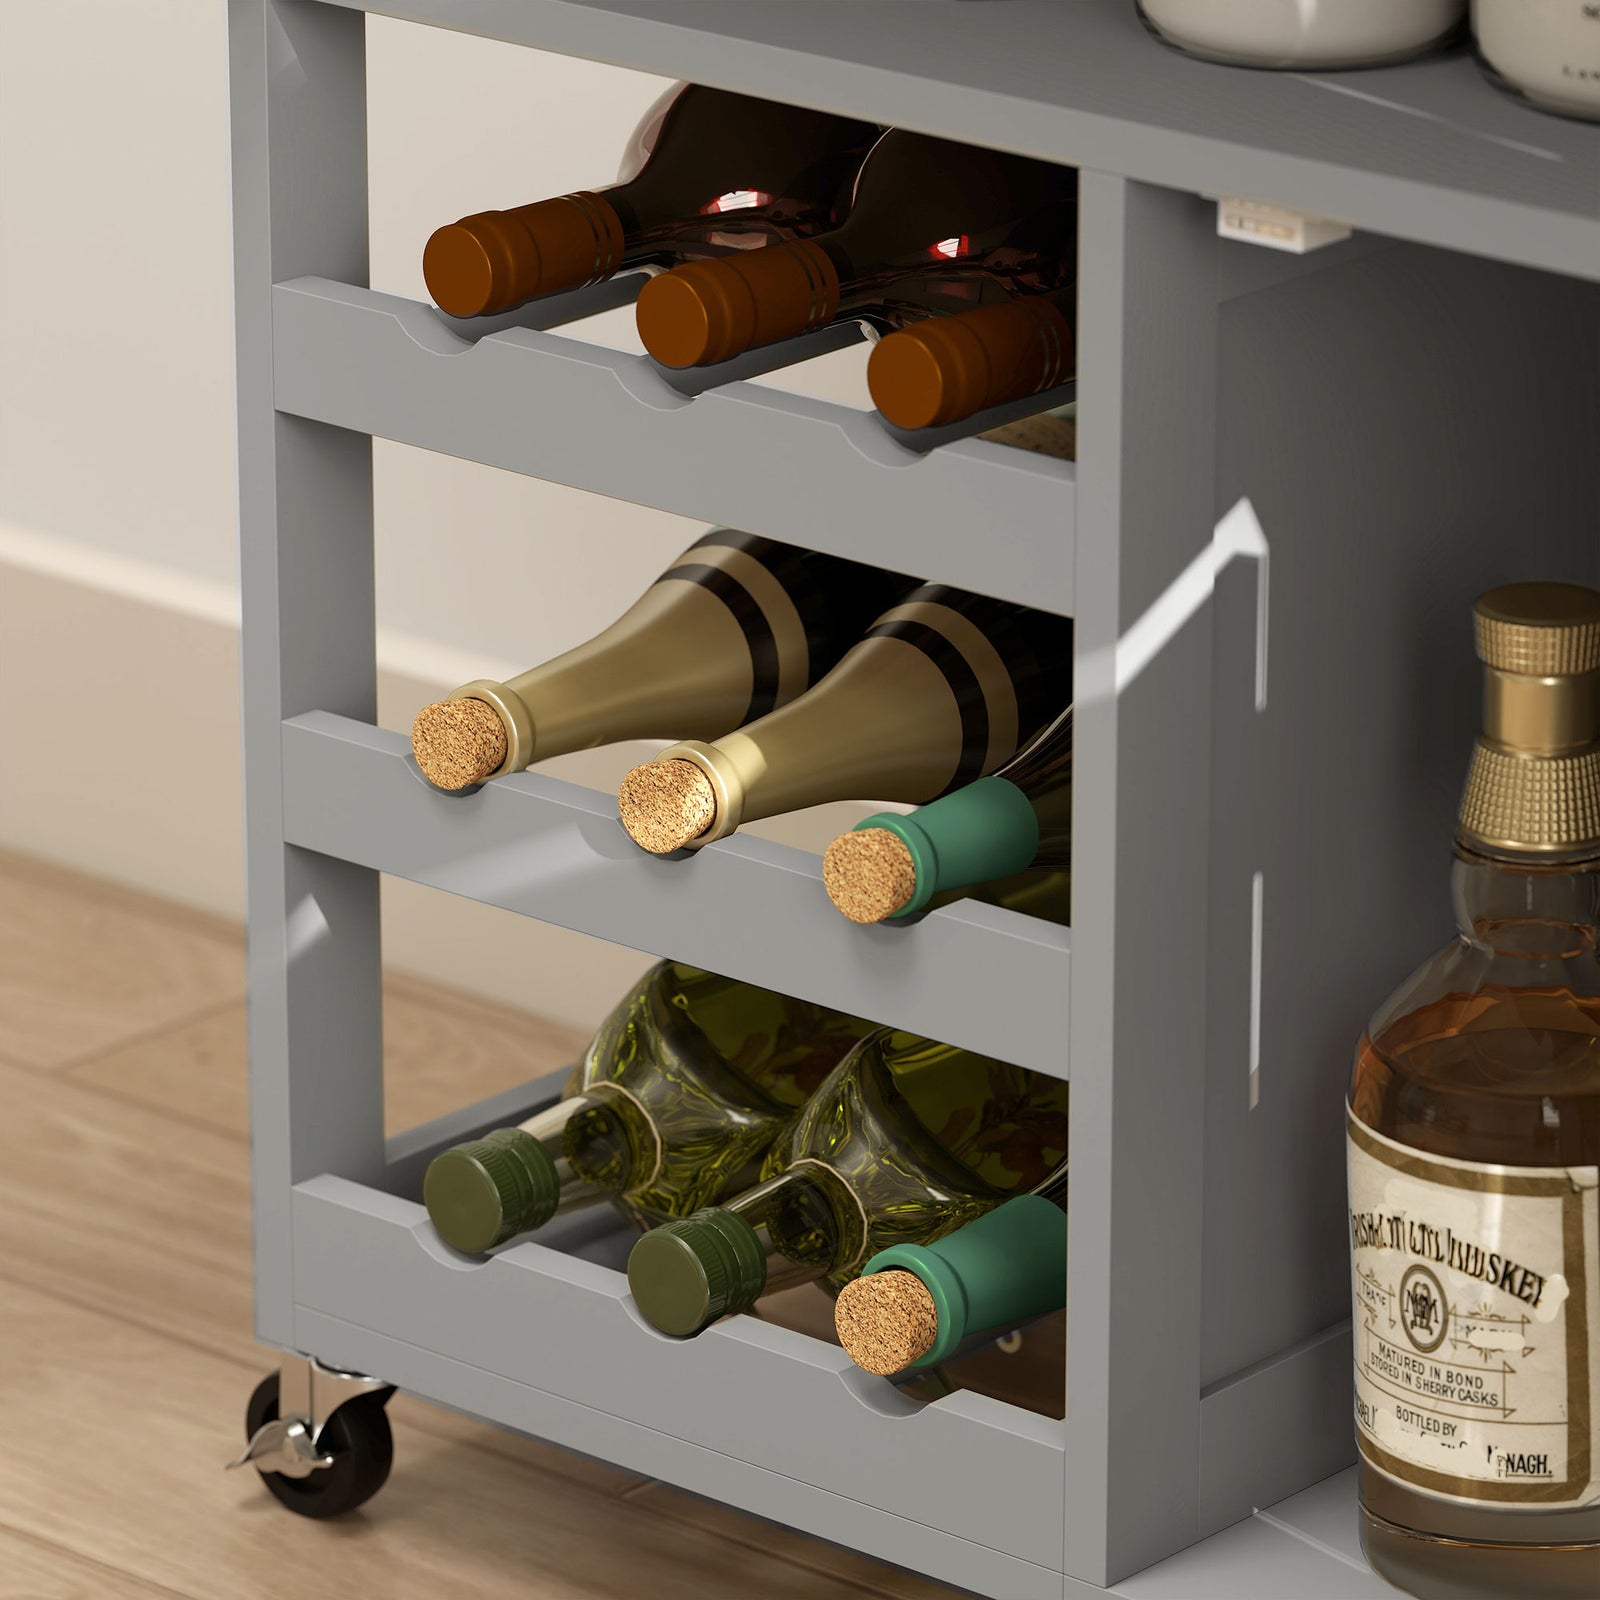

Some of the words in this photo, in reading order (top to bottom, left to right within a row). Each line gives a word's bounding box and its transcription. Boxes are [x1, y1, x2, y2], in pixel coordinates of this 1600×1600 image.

[1371, 1352, 1399, 1380] STORED
[1401, 1372, 1412, 1385] IN
[1416, 1376, 1457, 1399] SHERRY
[1458, 1388, 1499, 1407] CASKS
[1379, 1342, 1425, 1375] MATURED
[1430, 1366, 1440, 1380] IN
[1446, 1373, 1483, 1389] BOND
[1396, 1406, 1440, 1433] BOTTLED
[1443, 1422, 1457, 1437] BY
